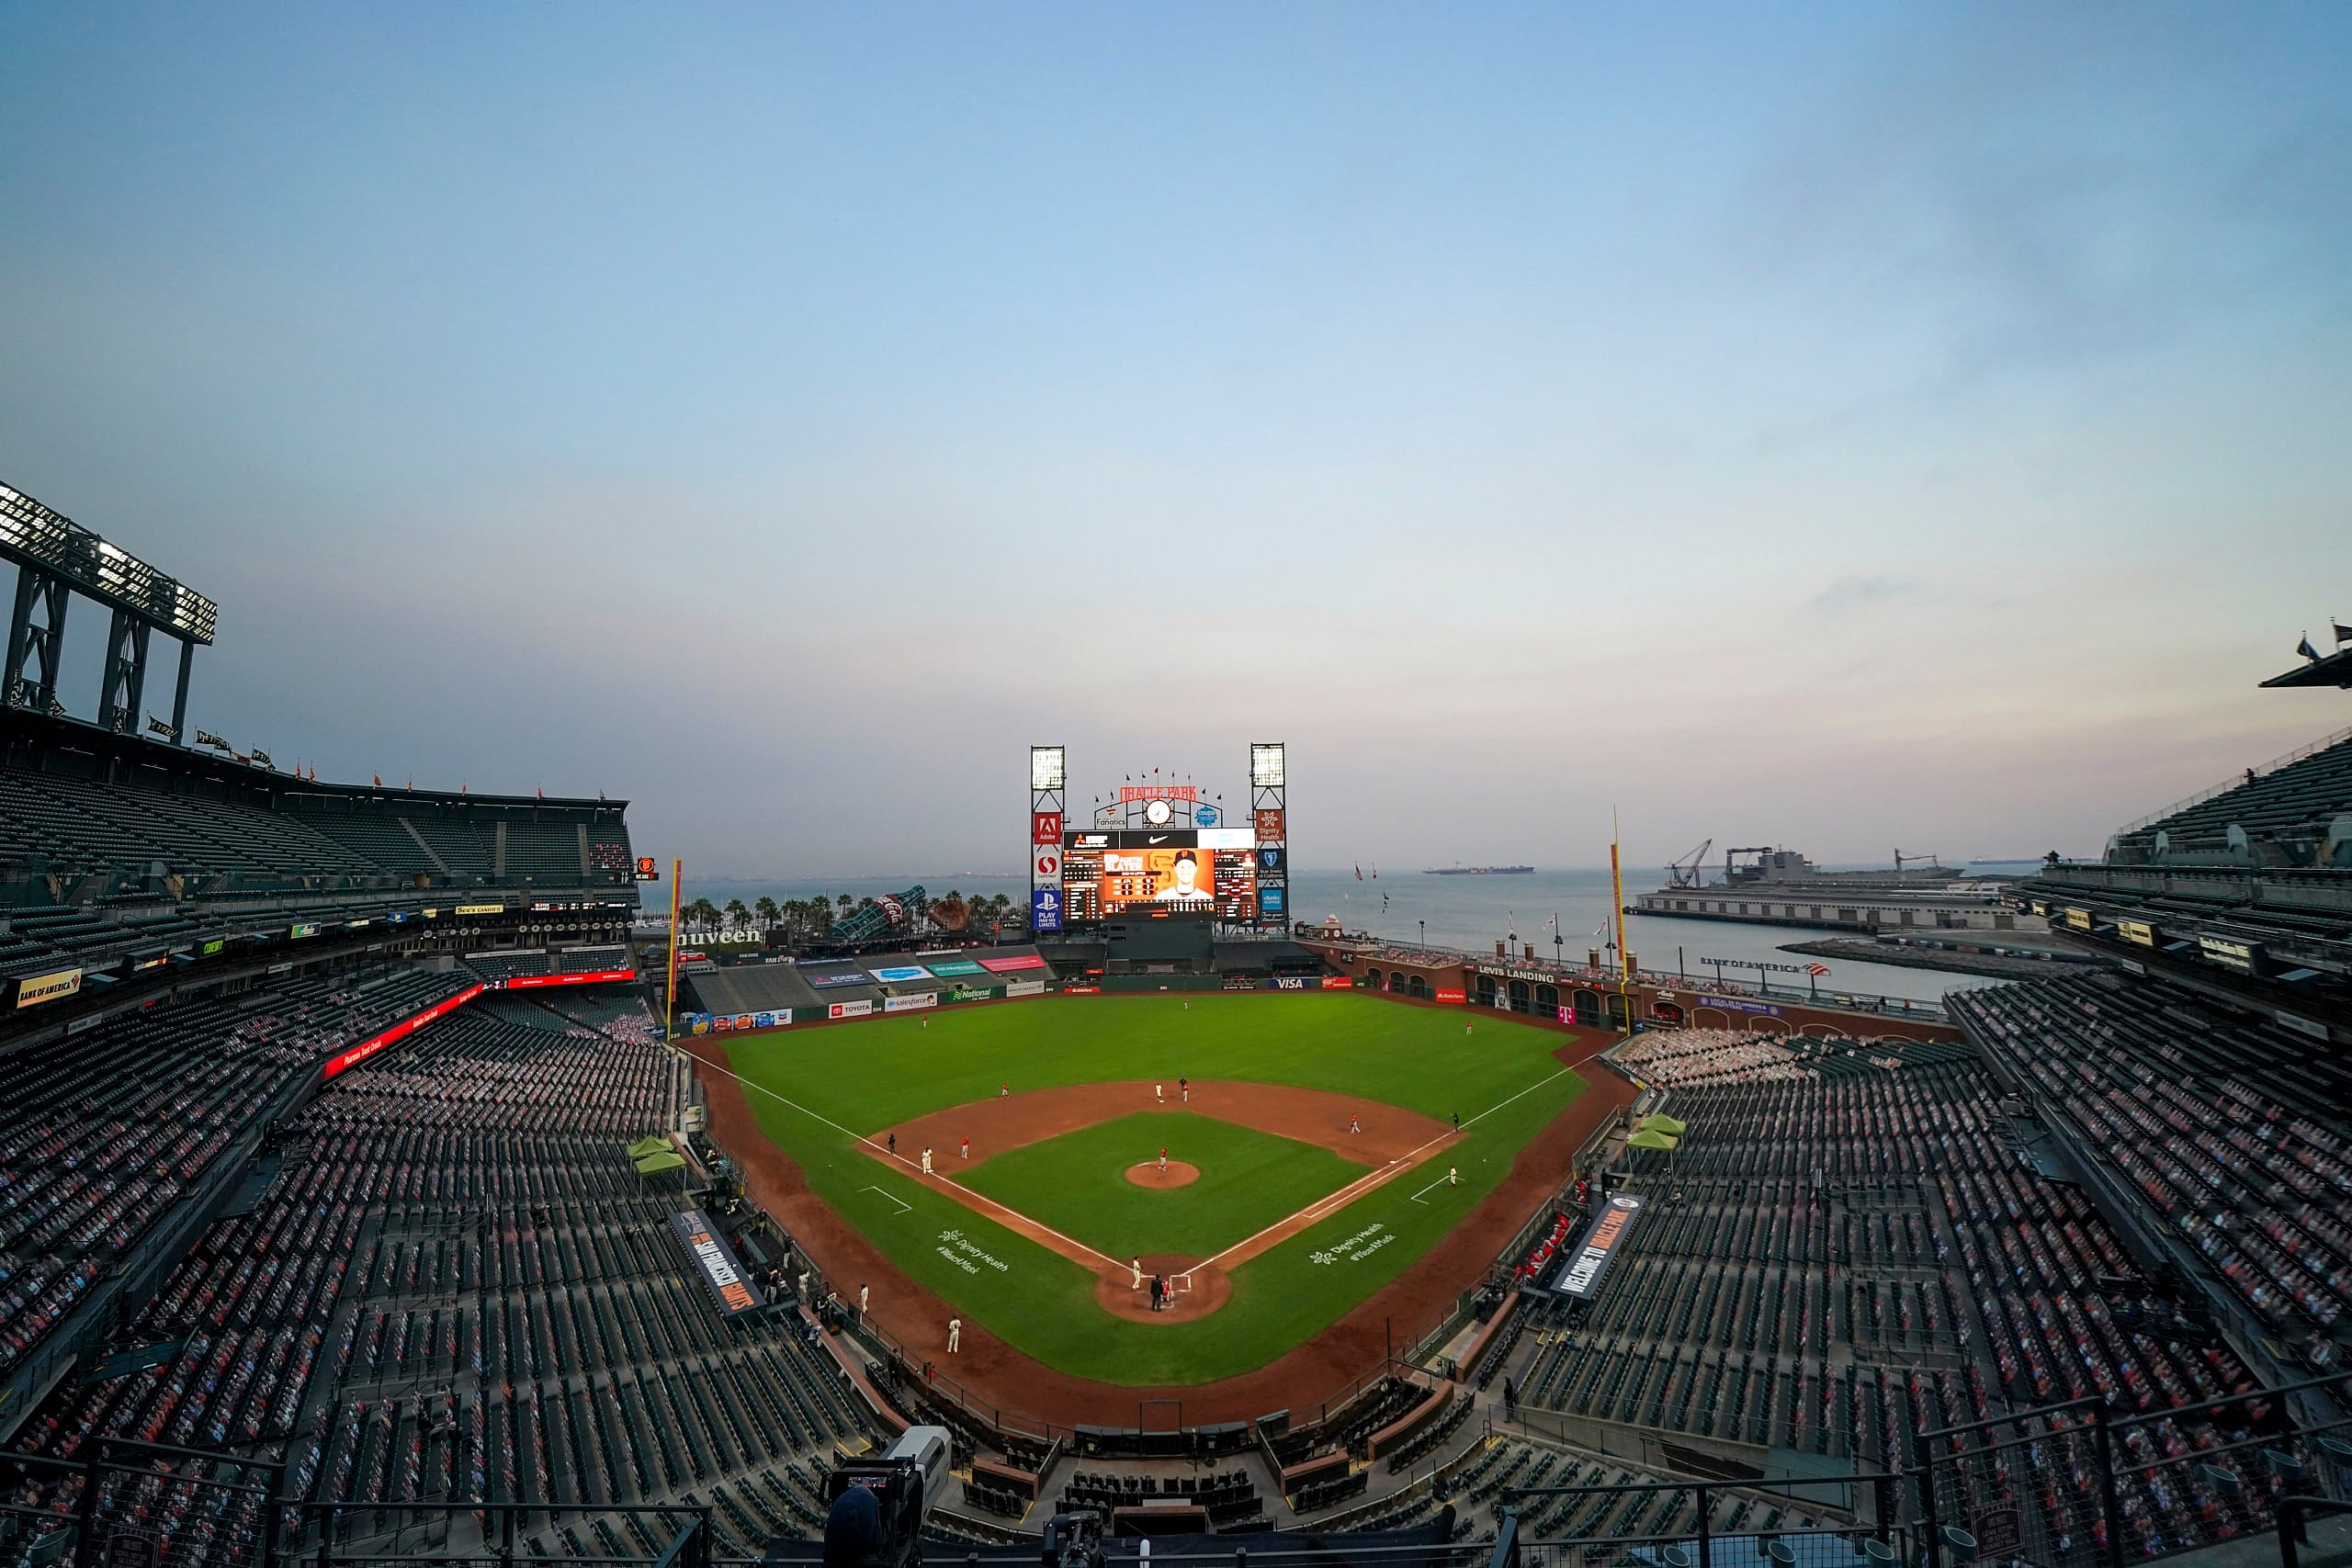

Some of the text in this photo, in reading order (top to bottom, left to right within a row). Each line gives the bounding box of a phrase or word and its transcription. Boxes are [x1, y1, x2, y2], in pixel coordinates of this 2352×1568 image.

[1119, 786, 1197, 802] ORACLE PARK
[676, 930, 763, 946] nuveen
[1700, 957, 1728, 966] BANK
[1746, 962, 1801, 973] AMERICA
[1278, 978, 1303, 988] VISA
[1507, 969, 1555, 984] LANDING
[20, 981, 71, 1001] BANK OF AMERICA
[962, 987, 990, 998] National
[845, 1004, 869, 1012] TOYOTA
[896, 998, 927, 1007] salesforce
[360, 1045, 370, 1057] Trust
[1330, 1224, 1385, 1253] Dignity Health
[695, 1240, 719, 1256] SAN
[956, 1240, 1009, 1272] Dignity Health
[1560, 1209, 1629, 1292] WELCOME TO ORACLE PARK
[700, 1250, 741, 1286] FRANCISCO
[719, 1282, 754, 1311] GIANTS
